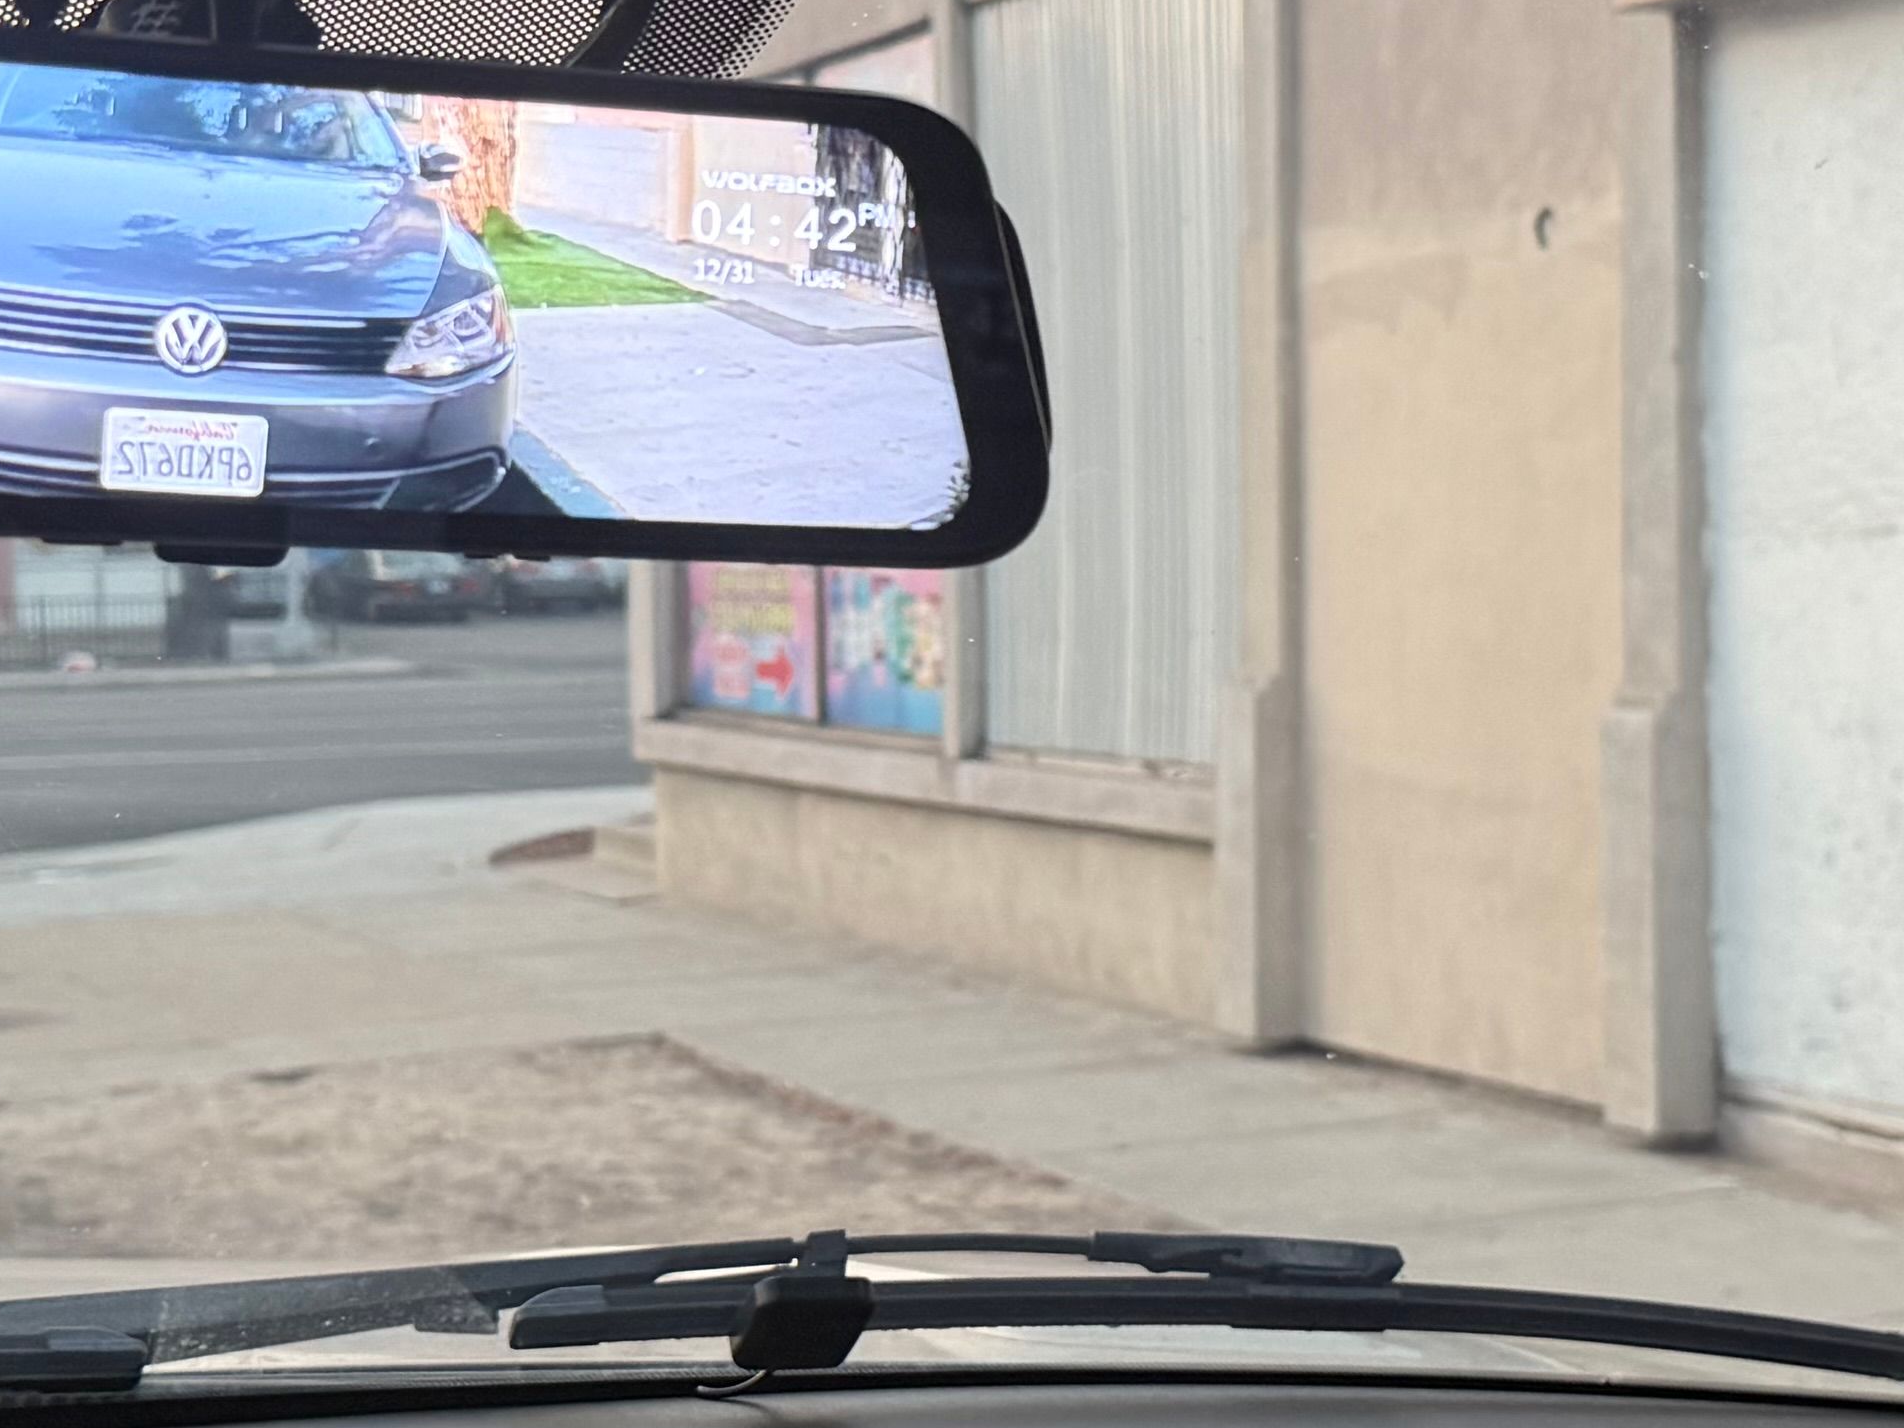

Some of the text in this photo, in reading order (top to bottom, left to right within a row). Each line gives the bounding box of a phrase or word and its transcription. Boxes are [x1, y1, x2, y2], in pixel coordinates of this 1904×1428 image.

[701, 169, 837, 198] WOLFBOX
[858, 202, 896, 228] PM
[693, 258, 755, 285] 12/31
